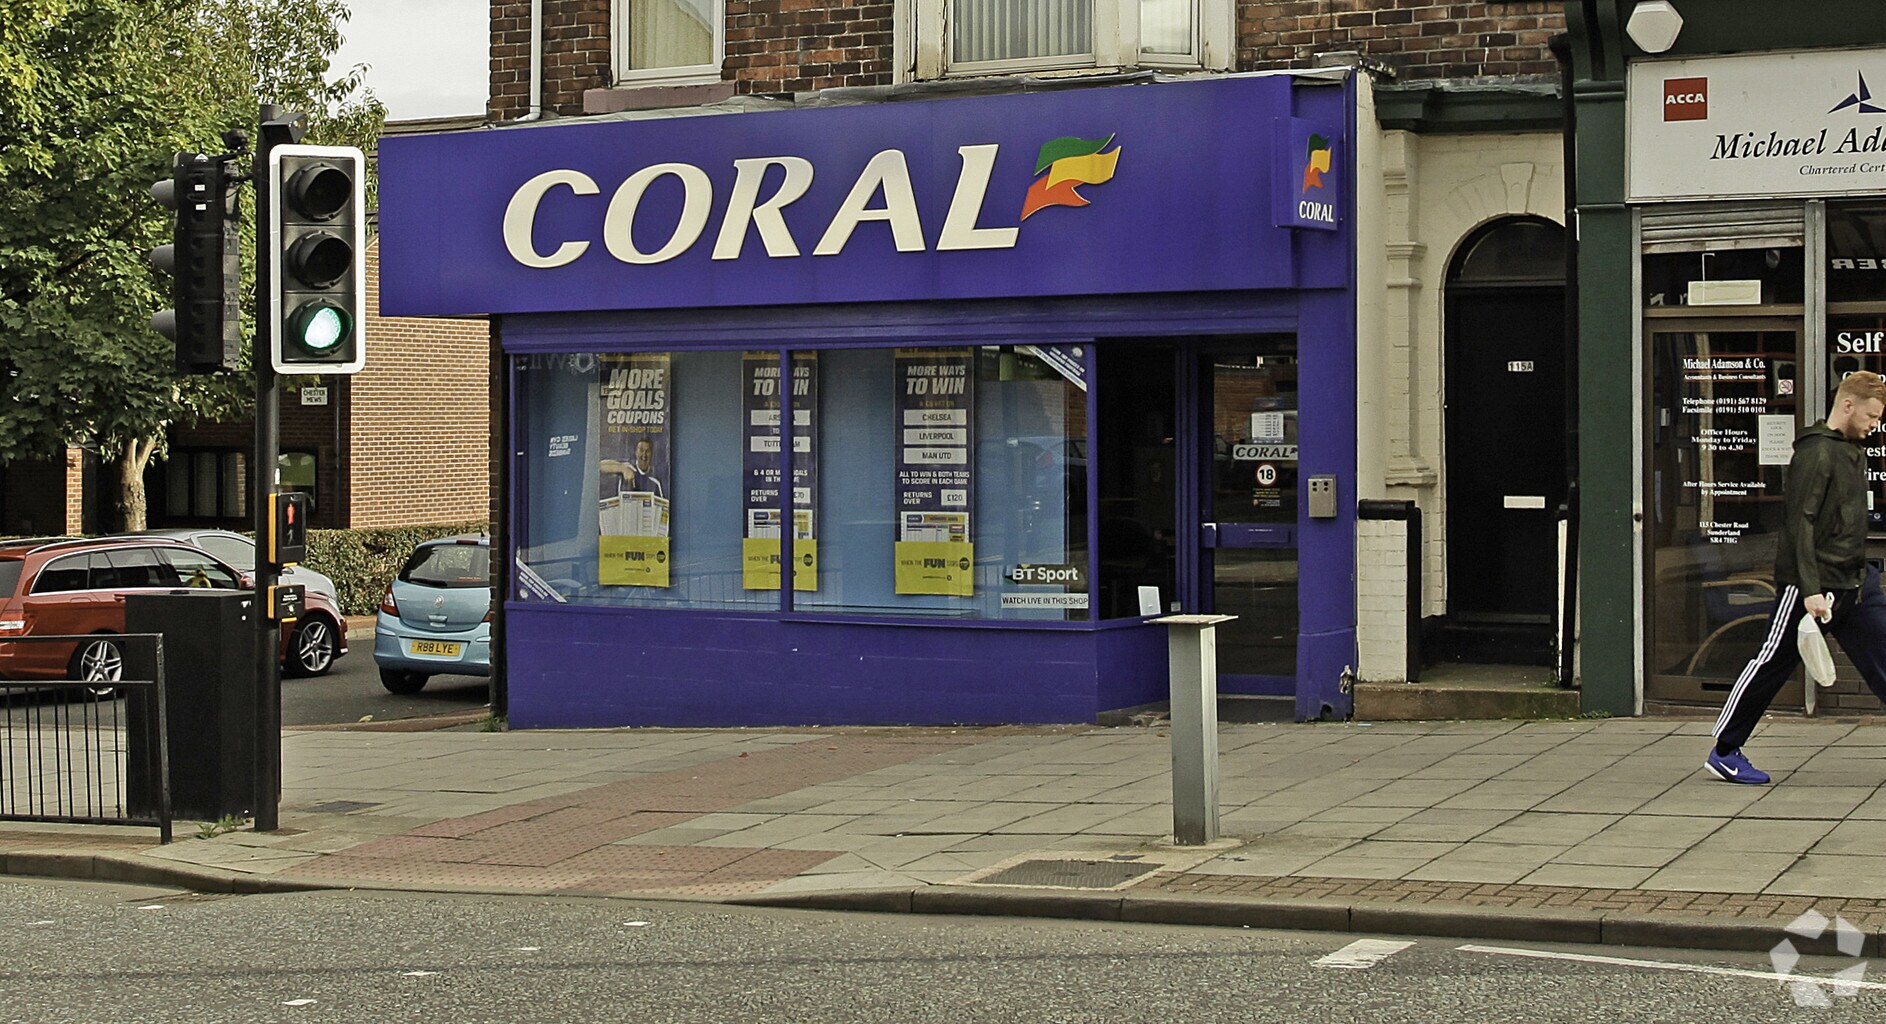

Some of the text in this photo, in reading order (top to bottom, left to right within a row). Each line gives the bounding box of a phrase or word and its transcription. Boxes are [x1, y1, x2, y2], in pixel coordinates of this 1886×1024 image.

[1665, 93, 1705, 105] ACCA
[1710, 127, 1827, 160] Michael
[1799, 162, 1886, 175] Chartered Cert
[502, 144, 1020, 269] CORAL
[1298, 200, 1334, 223] CORAL
[1836, 331, 1885, 353] Self
[1508, 362, 1533, 371] 115A
[1683, 357, 1766, 369] Michael Adamson & Co.
[907, 365, 966, 376] MORE WAYS
[608, 368, 664, 389] MORE
[753, 378, 775, 396] TO
[906, 377, 966, 395] TO WIN
[606, 390, 665, 410] GOALS
[1682, 397, 1767, 406] Telephone (0191) 567 8129
[1682, 406, 1766, 414] Facsimile (0191) 510 0101
[607, 410, 665, 424] COUPONS
[922, 413, 952, 421] CHELSEA
[919, 432, 954, 440] LIVERPOOL
[1700, 428, 1748, 436] Office Hours
[1691, 436, 1721, 444] Monday
[1732, 436, 1757, 444] Friday
[1235, 447, 1290, 458] CORAL
[899, 470, 910, 478] ALL
[910, 470, 919, 478] TO
[920, 470, 931, 478] WIN
[938, 470, 952, 478] BOTH
[1259, 469, 1274, 480] 18
[1701, 488, 1747, 496] by Appointment
[625, 551, 645, 561] FUN
[923, 558, 946, 568] FUN
[1012, 567, 1079, 583] BT Sport
[1002, 596, 1026, 604] WATCH
[416, 642, 454, 654] R88 LYE
